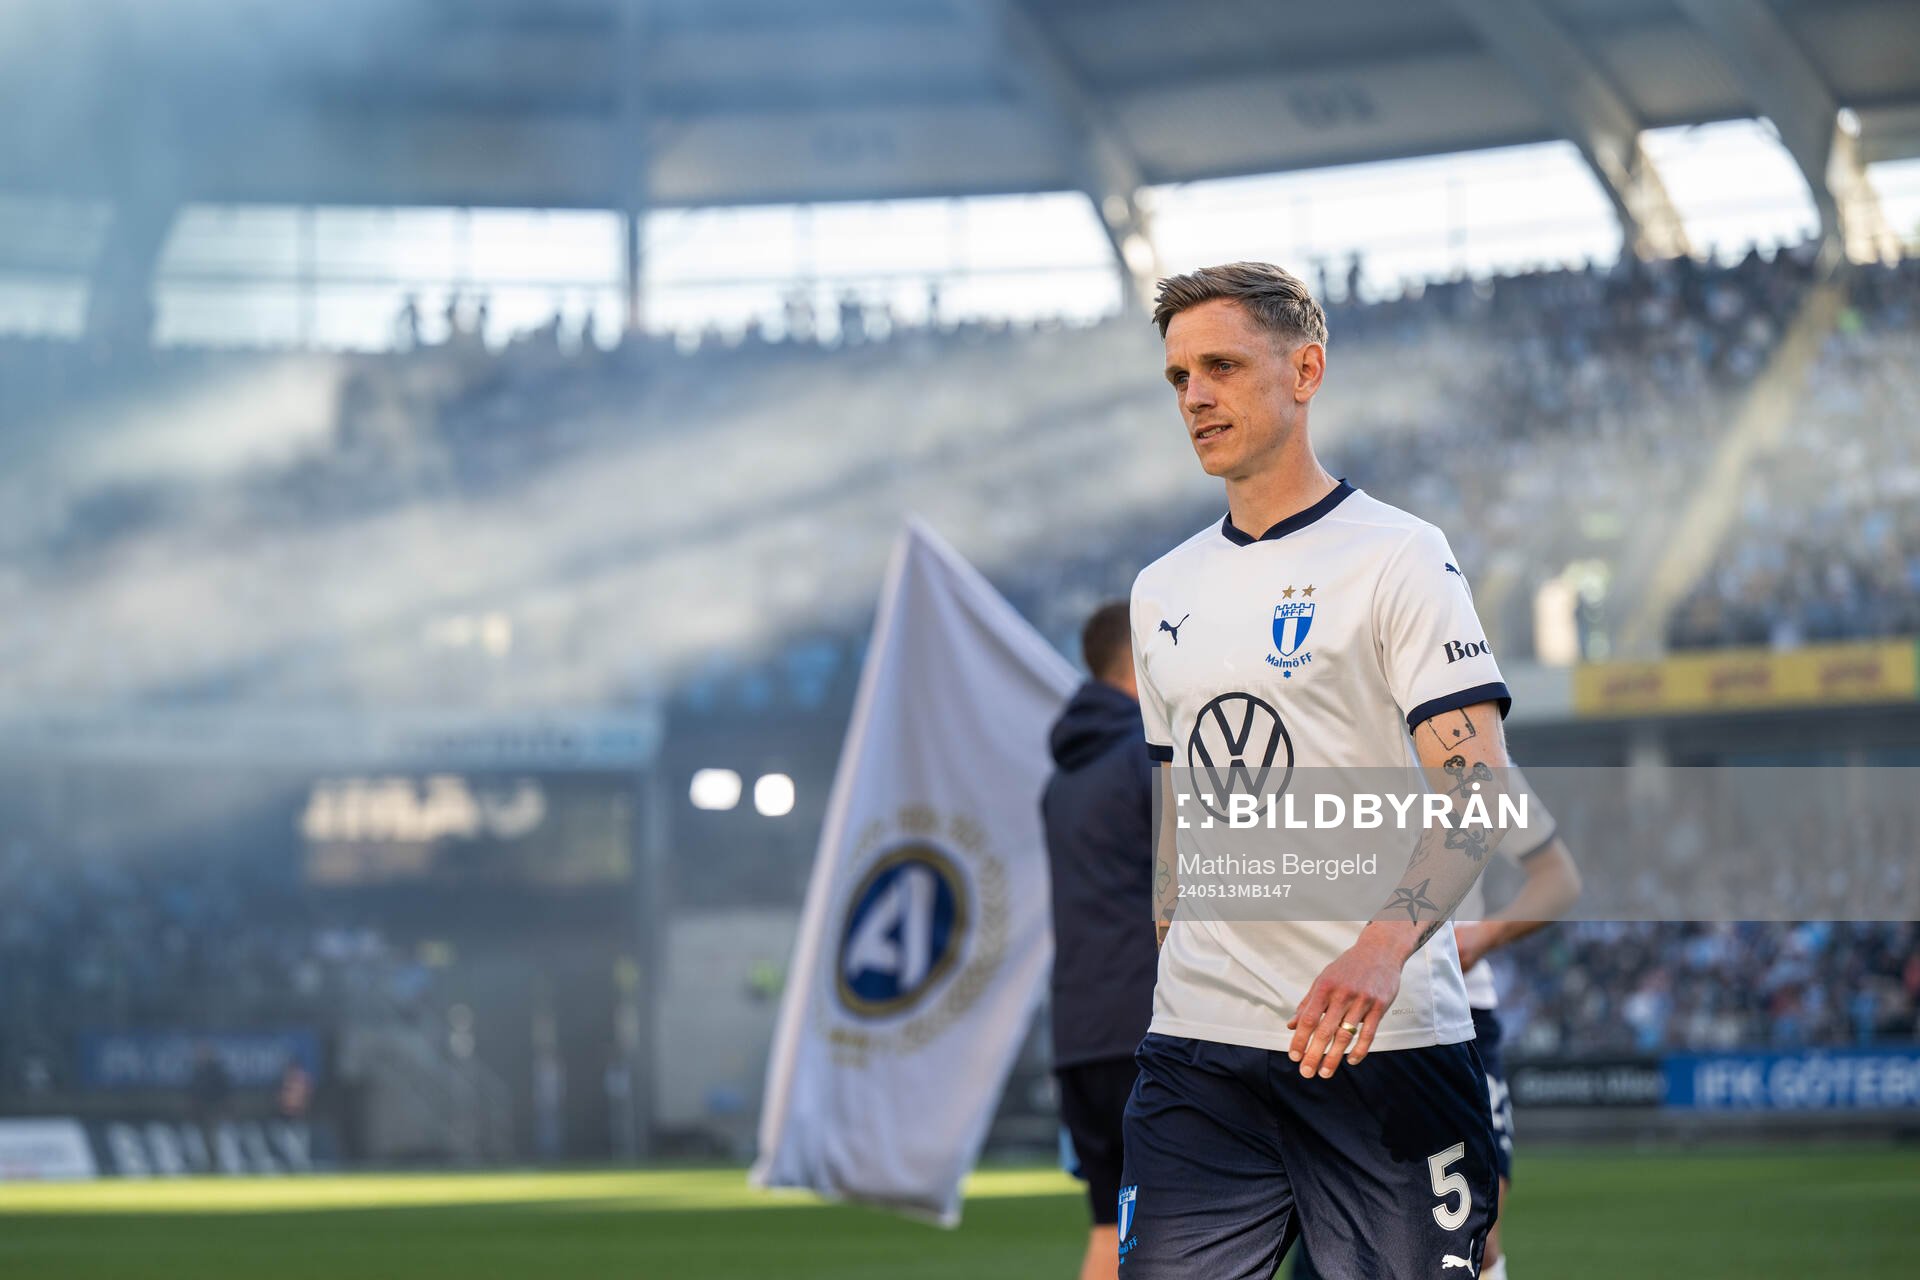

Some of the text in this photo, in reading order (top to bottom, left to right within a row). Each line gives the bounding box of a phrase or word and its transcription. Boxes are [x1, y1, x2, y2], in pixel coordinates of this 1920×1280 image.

[1265, 651, 1313, 669] Malmö FF
[1427, 1141, 1473, 1232] 5
